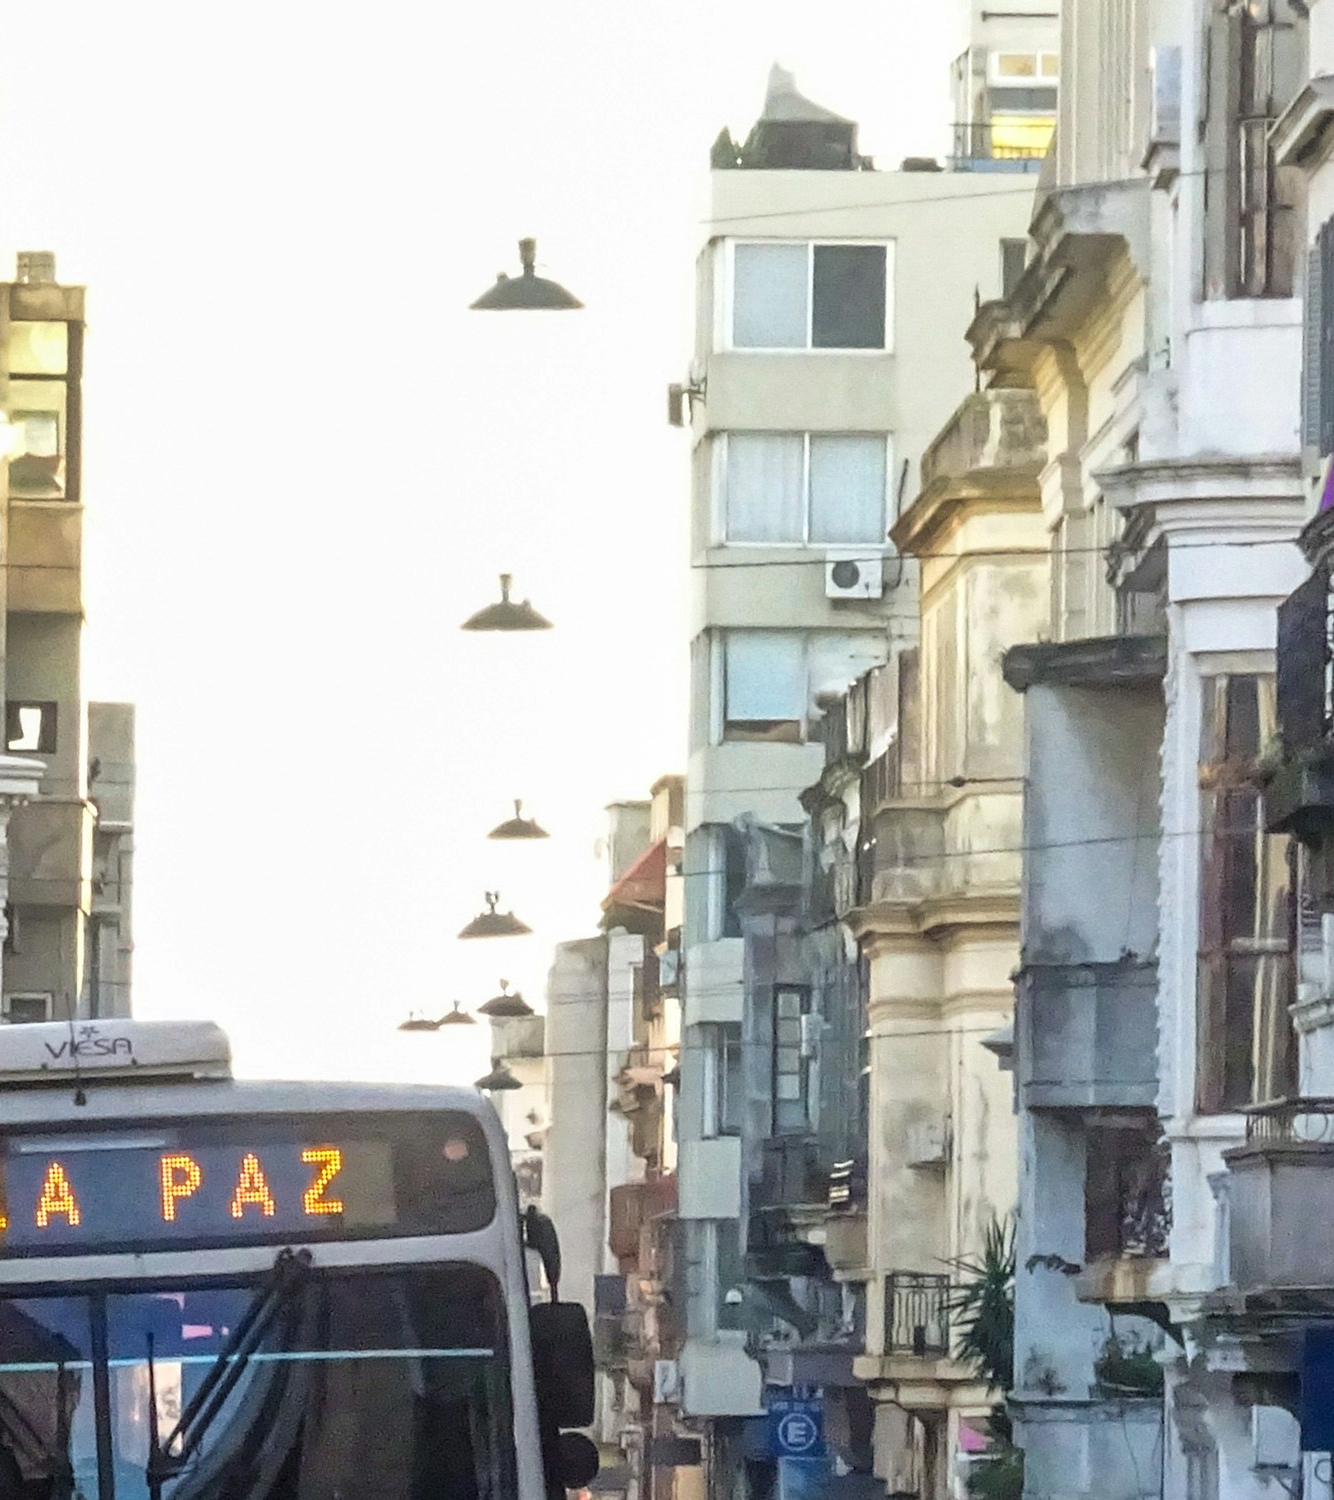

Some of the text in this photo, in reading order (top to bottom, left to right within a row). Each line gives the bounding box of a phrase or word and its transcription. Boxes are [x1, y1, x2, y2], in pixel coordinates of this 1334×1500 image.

[44, 1038, 133, 1059] VIESA
[161, 1149, 344, 1222] PAZ
[786, 1421, 807, 1444] E
